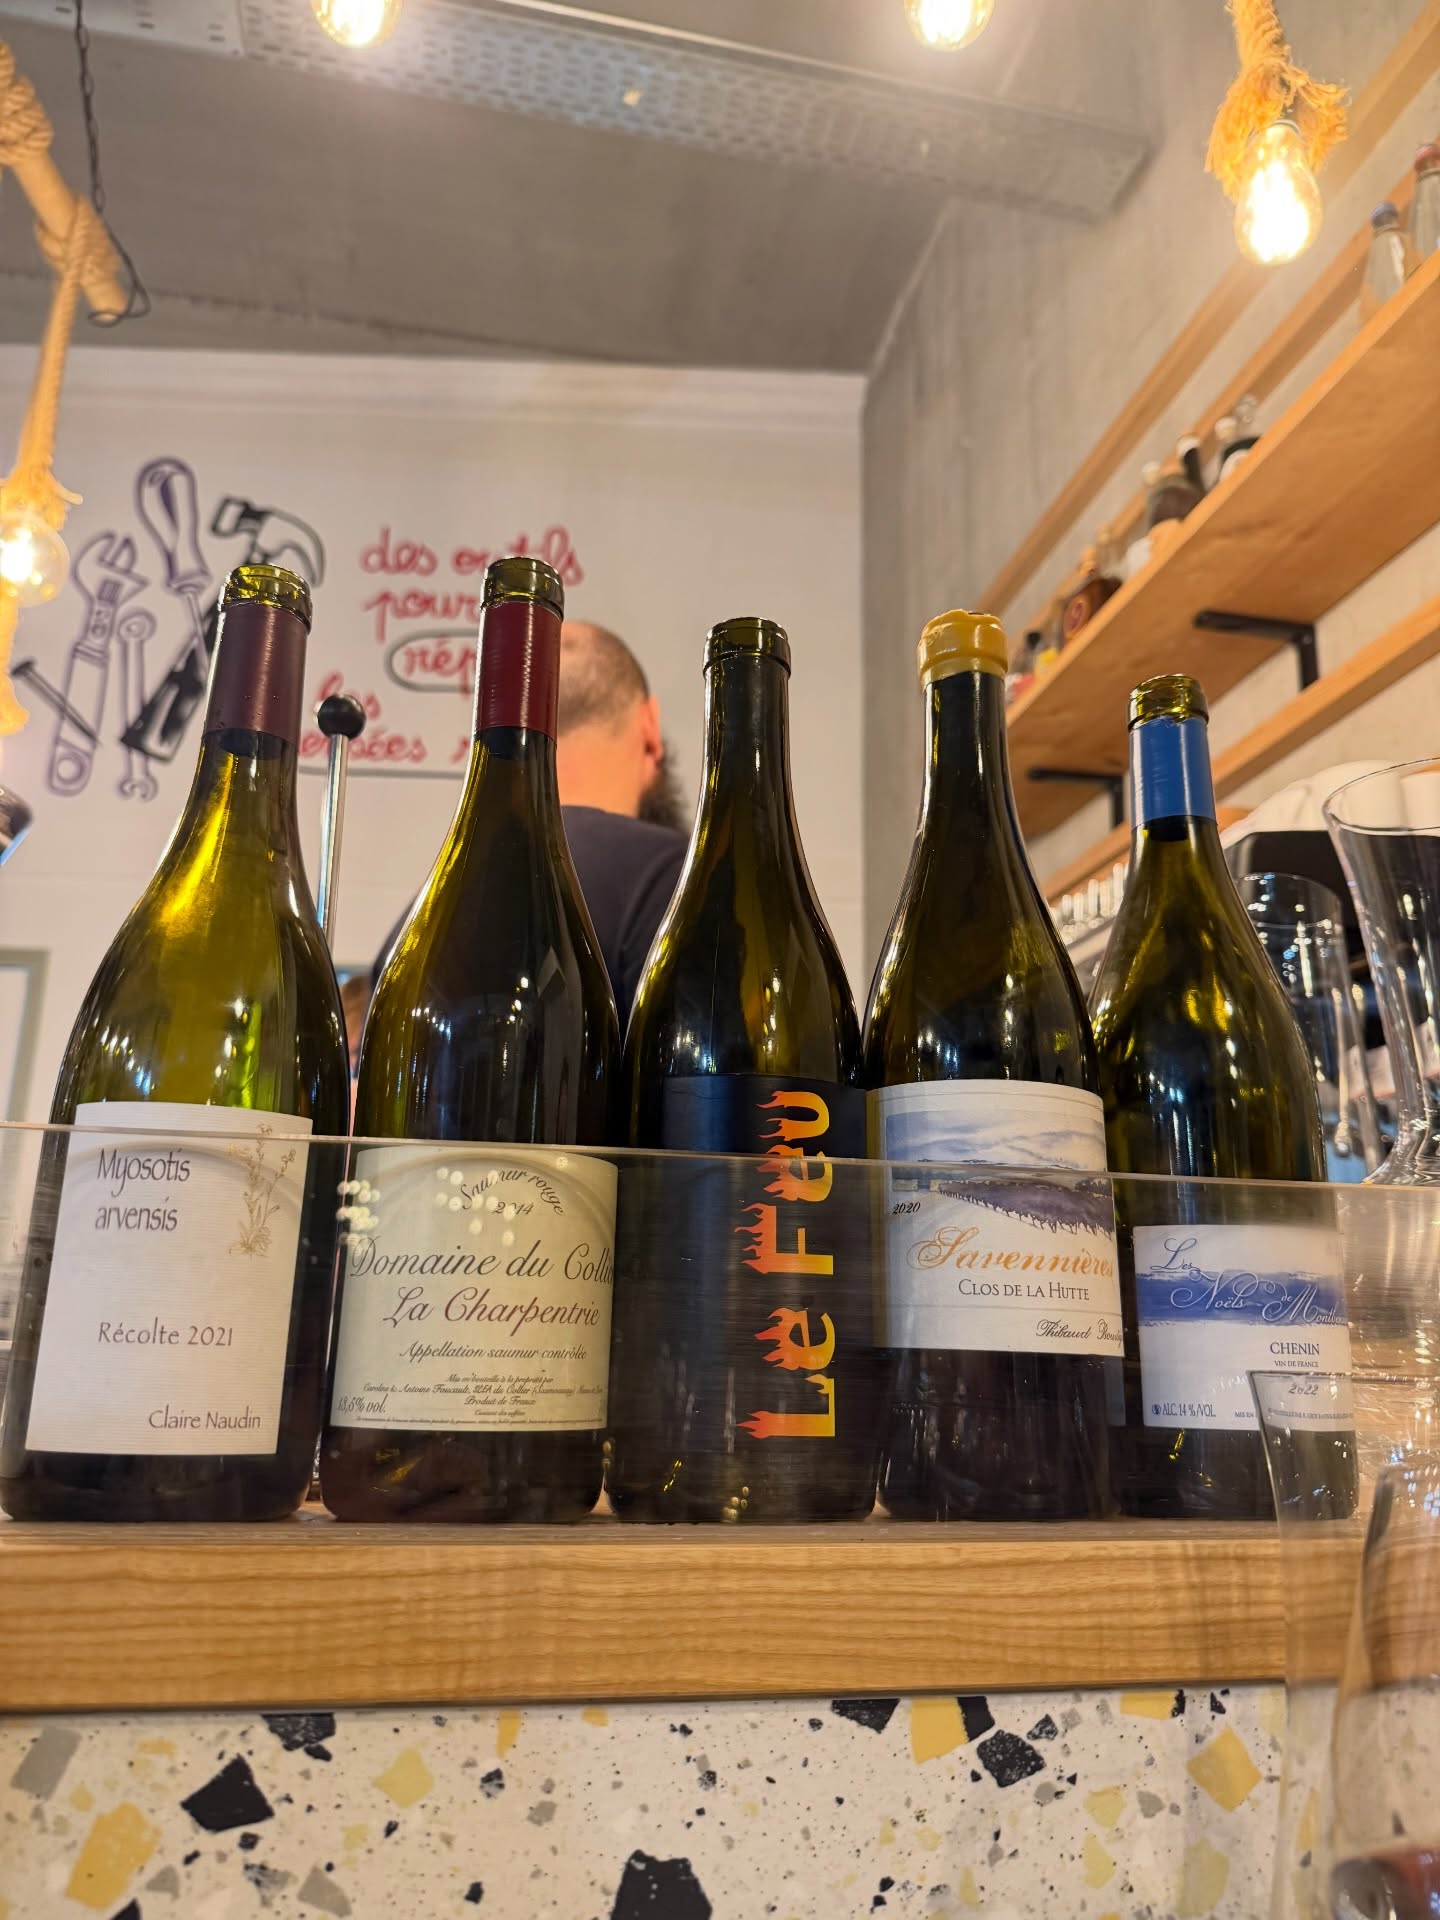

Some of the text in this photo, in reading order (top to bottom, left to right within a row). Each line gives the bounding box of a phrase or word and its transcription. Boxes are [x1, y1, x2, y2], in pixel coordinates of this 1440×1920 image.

[361, 527, 438, 577] des
[97, 1148, 191, 1197] Myosotis
[528, 1175, 565, 1215] rouge
[892, 1202, 921, 1215] 2020
[95, 1197, 178, 1231] arvensis
[350, 1235, 502, 1277] Domaine
[505, 1239, 554, 1278] du
[1150, 1238, 1202, 1271] Les
[1003, 1284, 1023, 1297] DE
[1026, 1284, 1045, 1298] LA
[382, 1286, 600, 1337] La Charpentrie
[98, 1316, 233, 1347] Récolte 2021
[1035, 1318, 1092, 1340] Thibaud
[400, 1340, 587, 1363] Appellation saumur contrôlée
[1269, 1341, 1321, 1356] CHENIN
[1287, 1360, 1297, 1368] DE
[1298, 1359, 1320, 1369] FRANCE
[736, 1307, 836, 1439] Le
[149, 1404, 261, 1430] Claire Naudin
[366, 1392, 387, 1413] vol.
